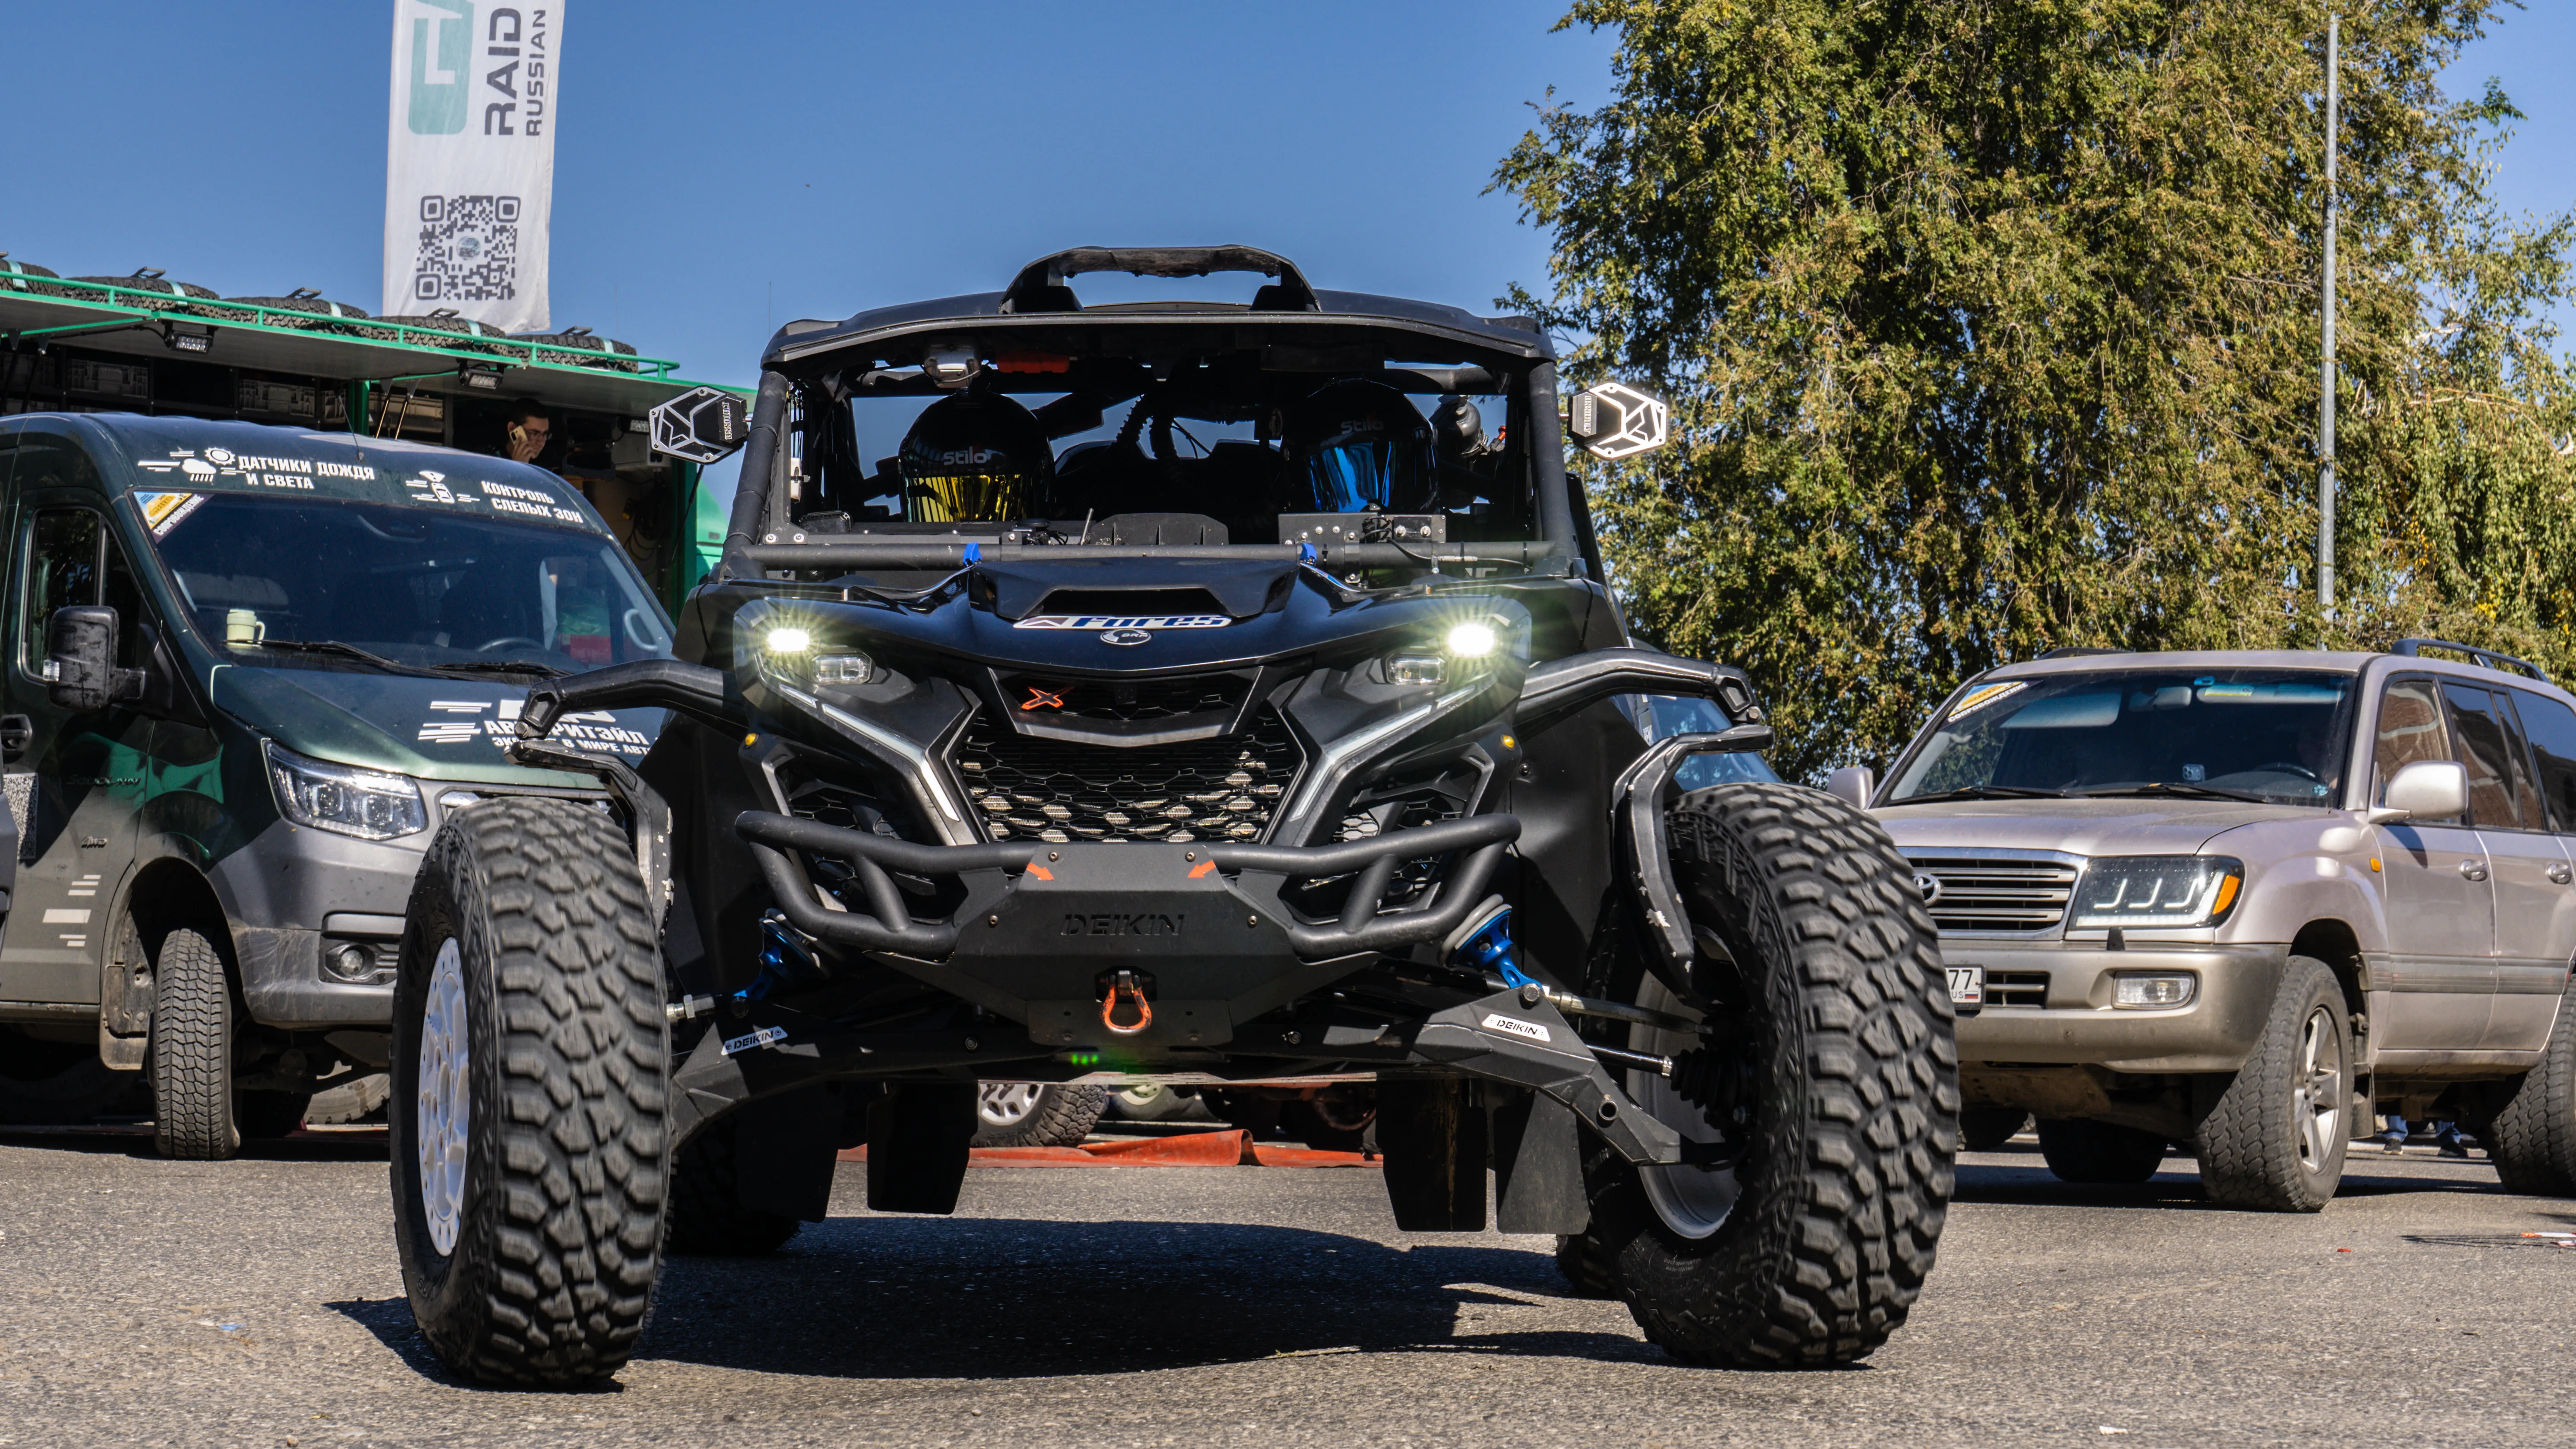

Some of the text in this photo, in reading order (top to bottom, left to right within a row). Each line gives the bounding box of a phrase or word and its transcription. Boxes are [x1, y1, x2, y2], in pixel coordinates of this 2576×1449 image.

[485, 8, 521, 135] RAID
[526, 9, 546, 136] RUSSIAN
[944, 446, 987, 465] stilo
[238, 456, 375, 480] ДАТЧИКИ ДОЖДЯ
[246, 473, 314, 489] И СВЕТА
[481, 480, 554, 504] КОНТРОЛЬ
[491, 497, 583, 523] СЛЕПЫХ ЗОН
[1947, 681, 2028, 723] СОПРОВОЖДЕНИЕ
[484, 720, 649, 745] АВРИТЭЙЛ
[561, 739, 575, 748] В
[576, 739, 620, 751] МИРЕ
[623, 744, 650, 754] АВТ
[1061, 914, 1184, 935] DEIKIN
[1496, 1019, 1538, 1035] DEIKIN
[734, 1031, 774, 1049] DEIKIN
